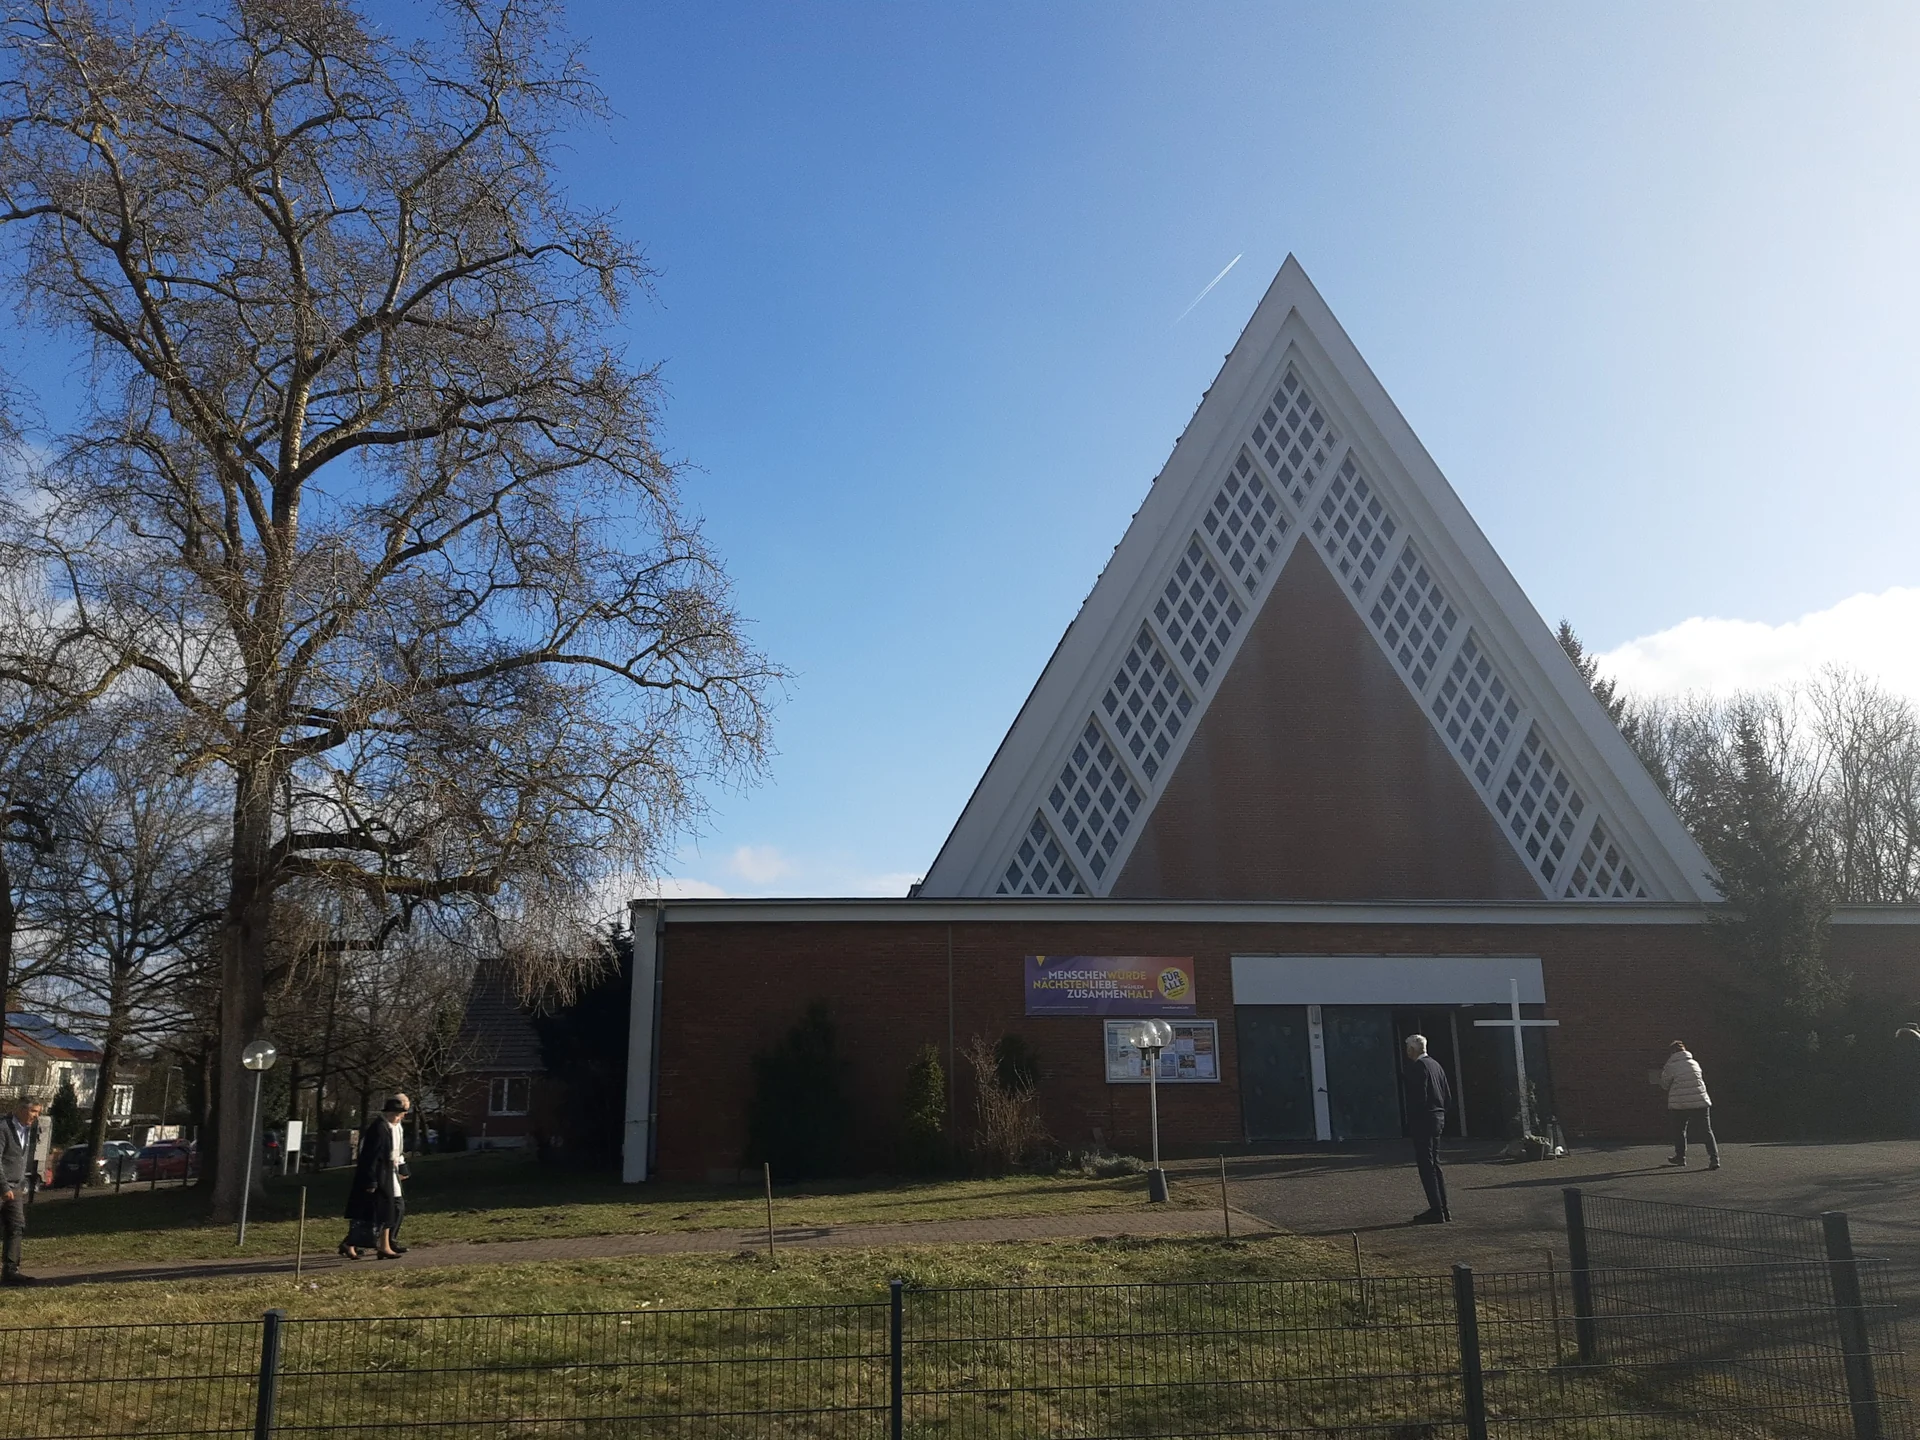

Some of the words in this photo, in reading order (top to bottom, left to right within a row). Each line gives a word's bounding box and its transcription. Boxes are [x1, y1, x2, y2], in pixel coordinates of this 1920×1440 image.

[1048, 969, 1146, 980] MENSCHENWÜRDE
[1161, 971, 1180, 984] FÜR
[1033, 976, 1118, 989] NÄCHSTENLIEBE
[1164, 978, 1185, 992] ALLE
[1067, 989, 1154, 999] ZUSAMMENHALT
